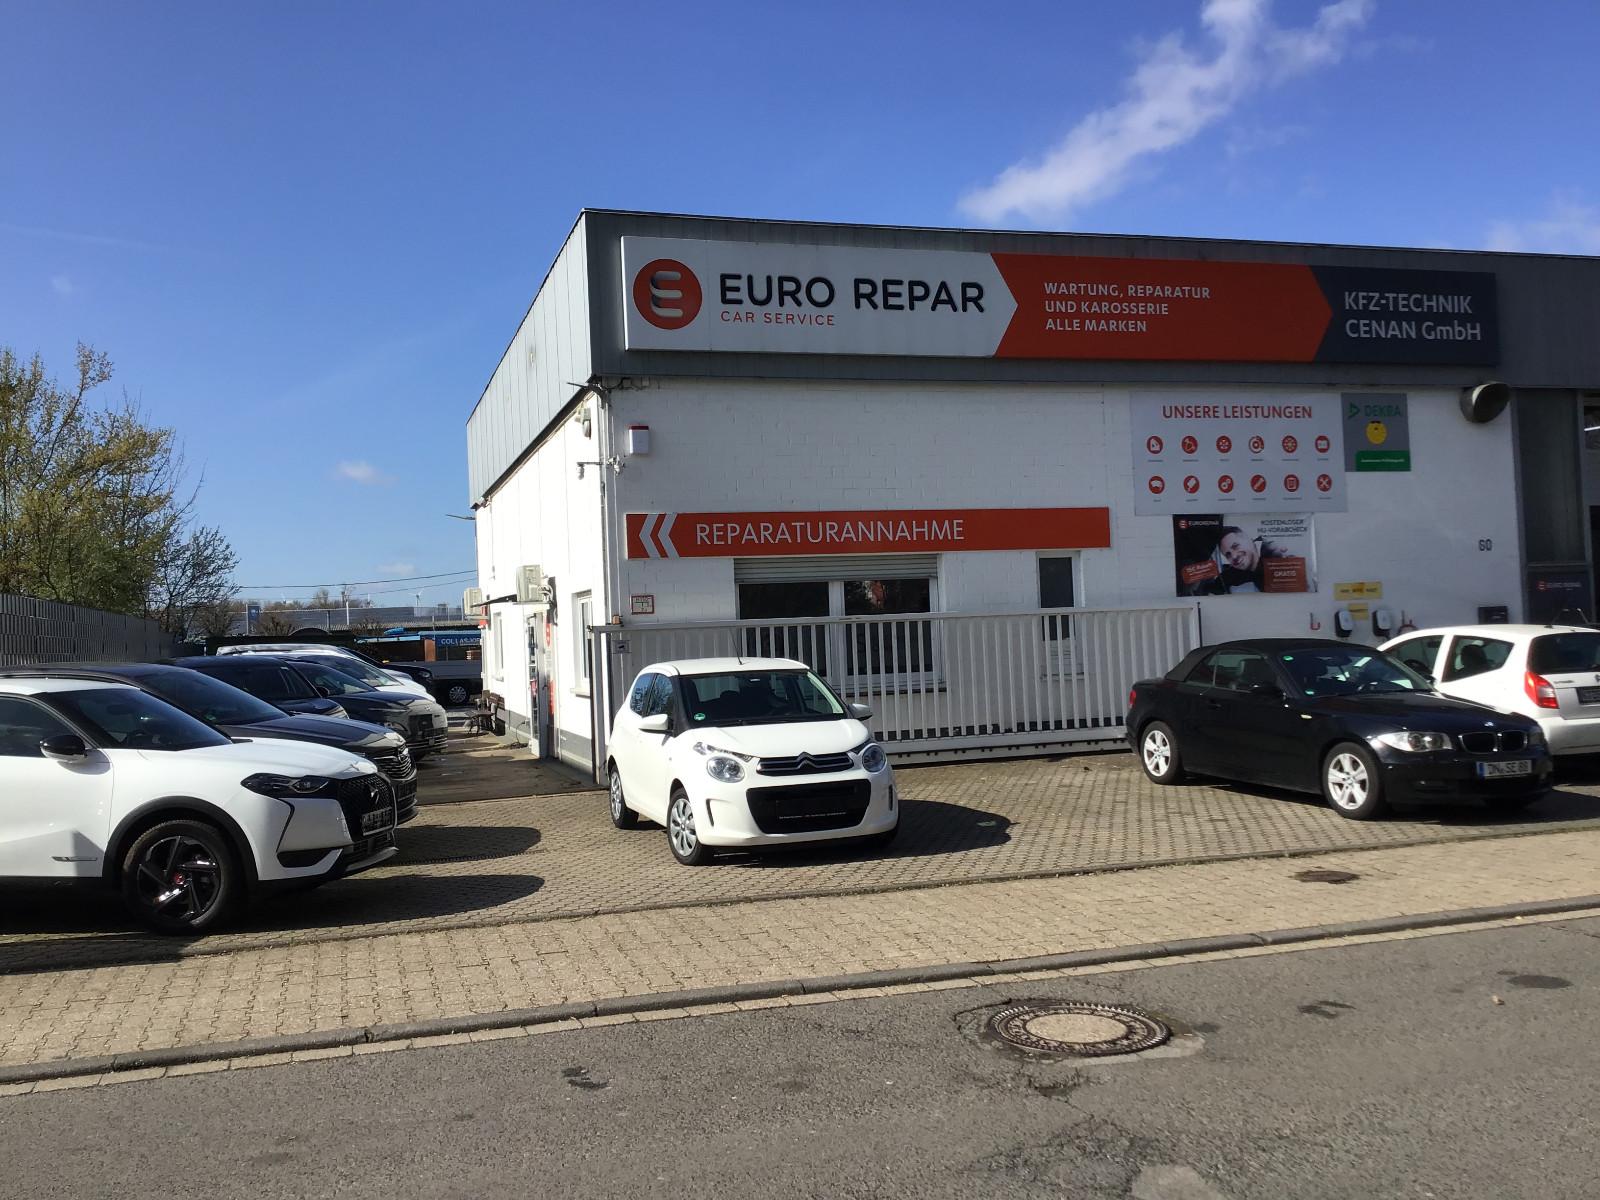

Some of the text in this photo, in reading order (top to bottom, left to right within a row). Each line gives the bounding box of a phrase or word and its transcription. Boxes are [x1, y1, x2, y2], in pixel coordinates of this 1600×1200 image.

[719, 273, 985, 313] EURO REPAR
[1043, 282, 1211, 300] WARTUNG, REPARATUR
[1044, 300, 1169, 316] UND KAROSSERIE
[1343, 291, 1473, 315] KFZ-TECHNIK
[720, 310, 836, 326] CAR SERVICE
[1045, 318, 1147, 333] ALLE MARKEN
[1344, 318, 1482, 341] CENAN GmbH
[1162, 405, 1313, 419] UNSERE LEISTUNGEN
[1364, 404, 1403, 417] DEKRA
[695, 519, 965, 545] REPARATURANNAHME
